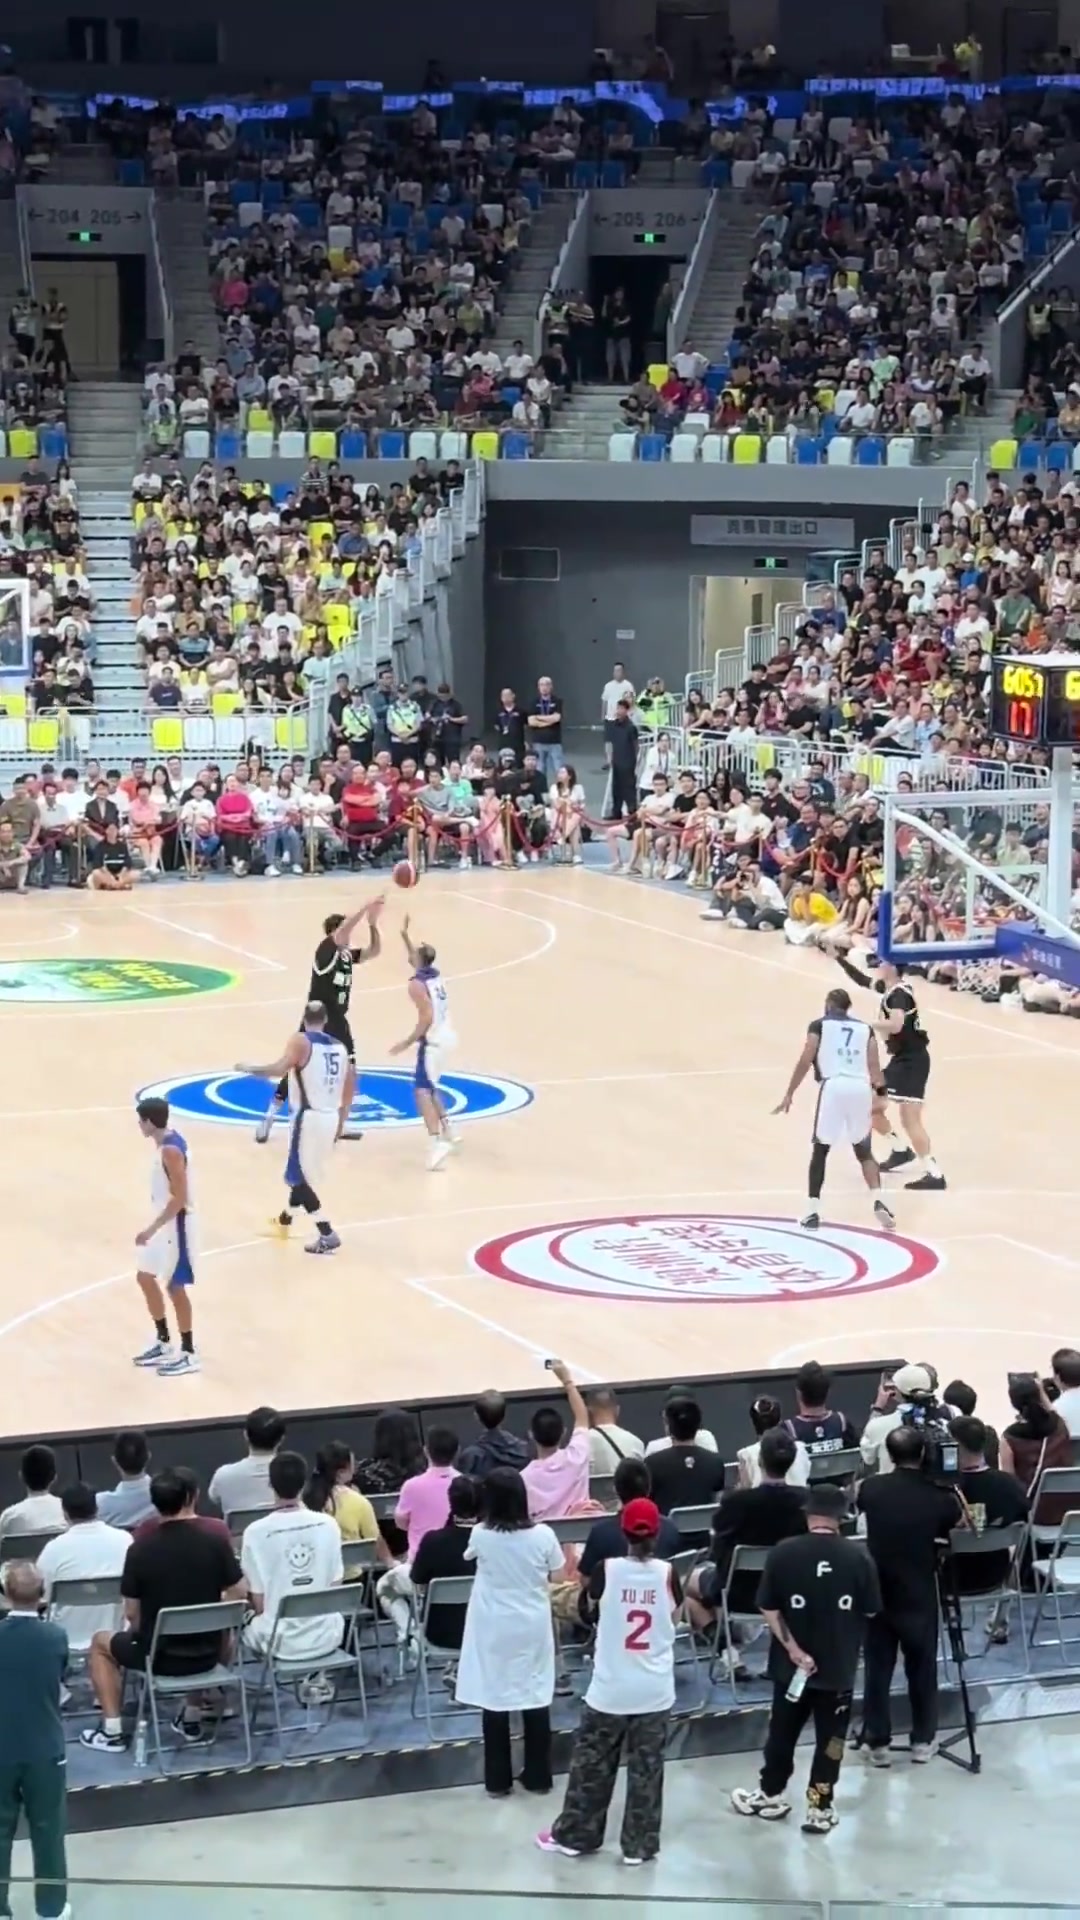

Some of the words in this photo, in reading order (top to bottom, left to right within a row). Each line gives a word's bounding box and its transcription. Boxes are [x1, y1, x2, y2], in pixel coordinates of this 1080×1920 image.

[841, 1027, 853, 1047] 7
[323, 1052, 339, 1076] 15
[816, 1560, 833, 1577] F
[621, 1588, 637, 1604] XU
[640, 1589, 656, 1605] JIE
[625, 1610, 652, 1650] 2
